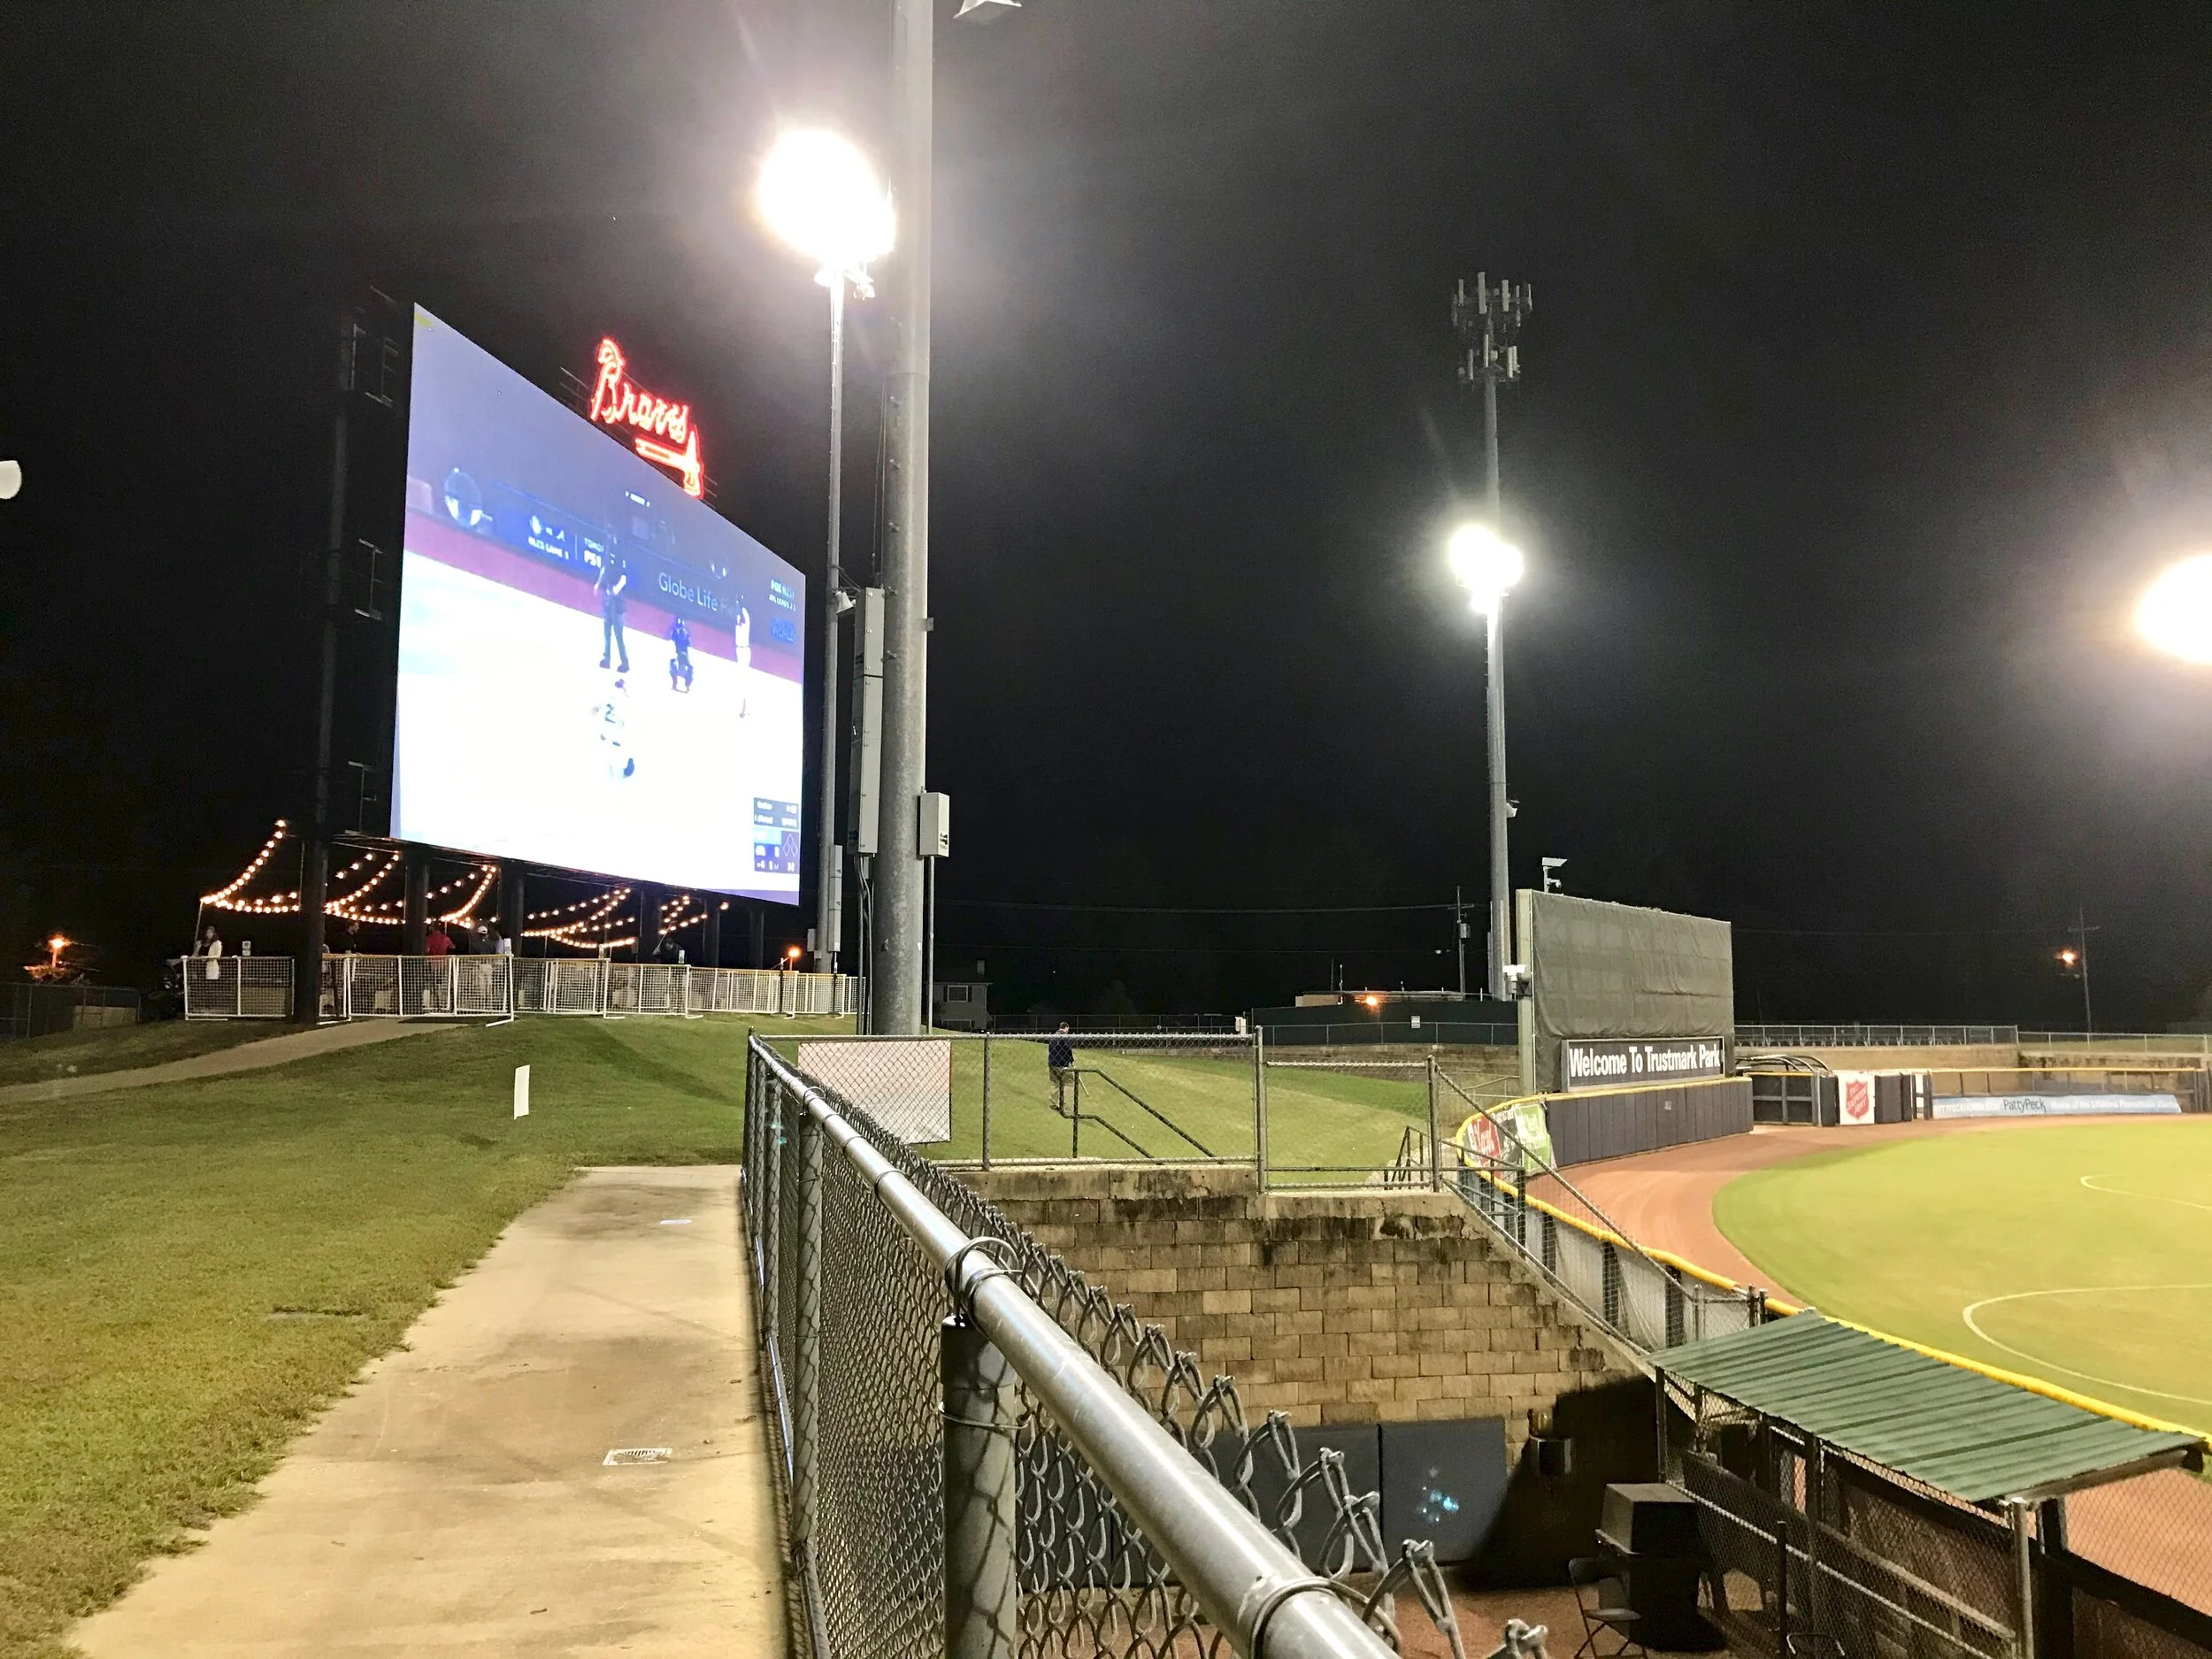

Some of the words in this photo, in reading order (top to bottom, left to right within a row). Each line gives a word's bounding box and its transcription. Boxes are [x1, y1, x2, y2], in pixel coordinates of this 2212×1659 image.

[590, 337, 689, 444] Braves
[658, 572, 695, 602] Globe
[697, 587, 718, 612] Life
[1569, 1048, 1627, 1078] Welcome
[1629, 1046, 1643, 1073] To
[1644, 1045, 1698, 1072] Trustmark
[1699, 1043, 1721, 1069] Park
[2003, 1098, 2047, 1113] PattyPeck
